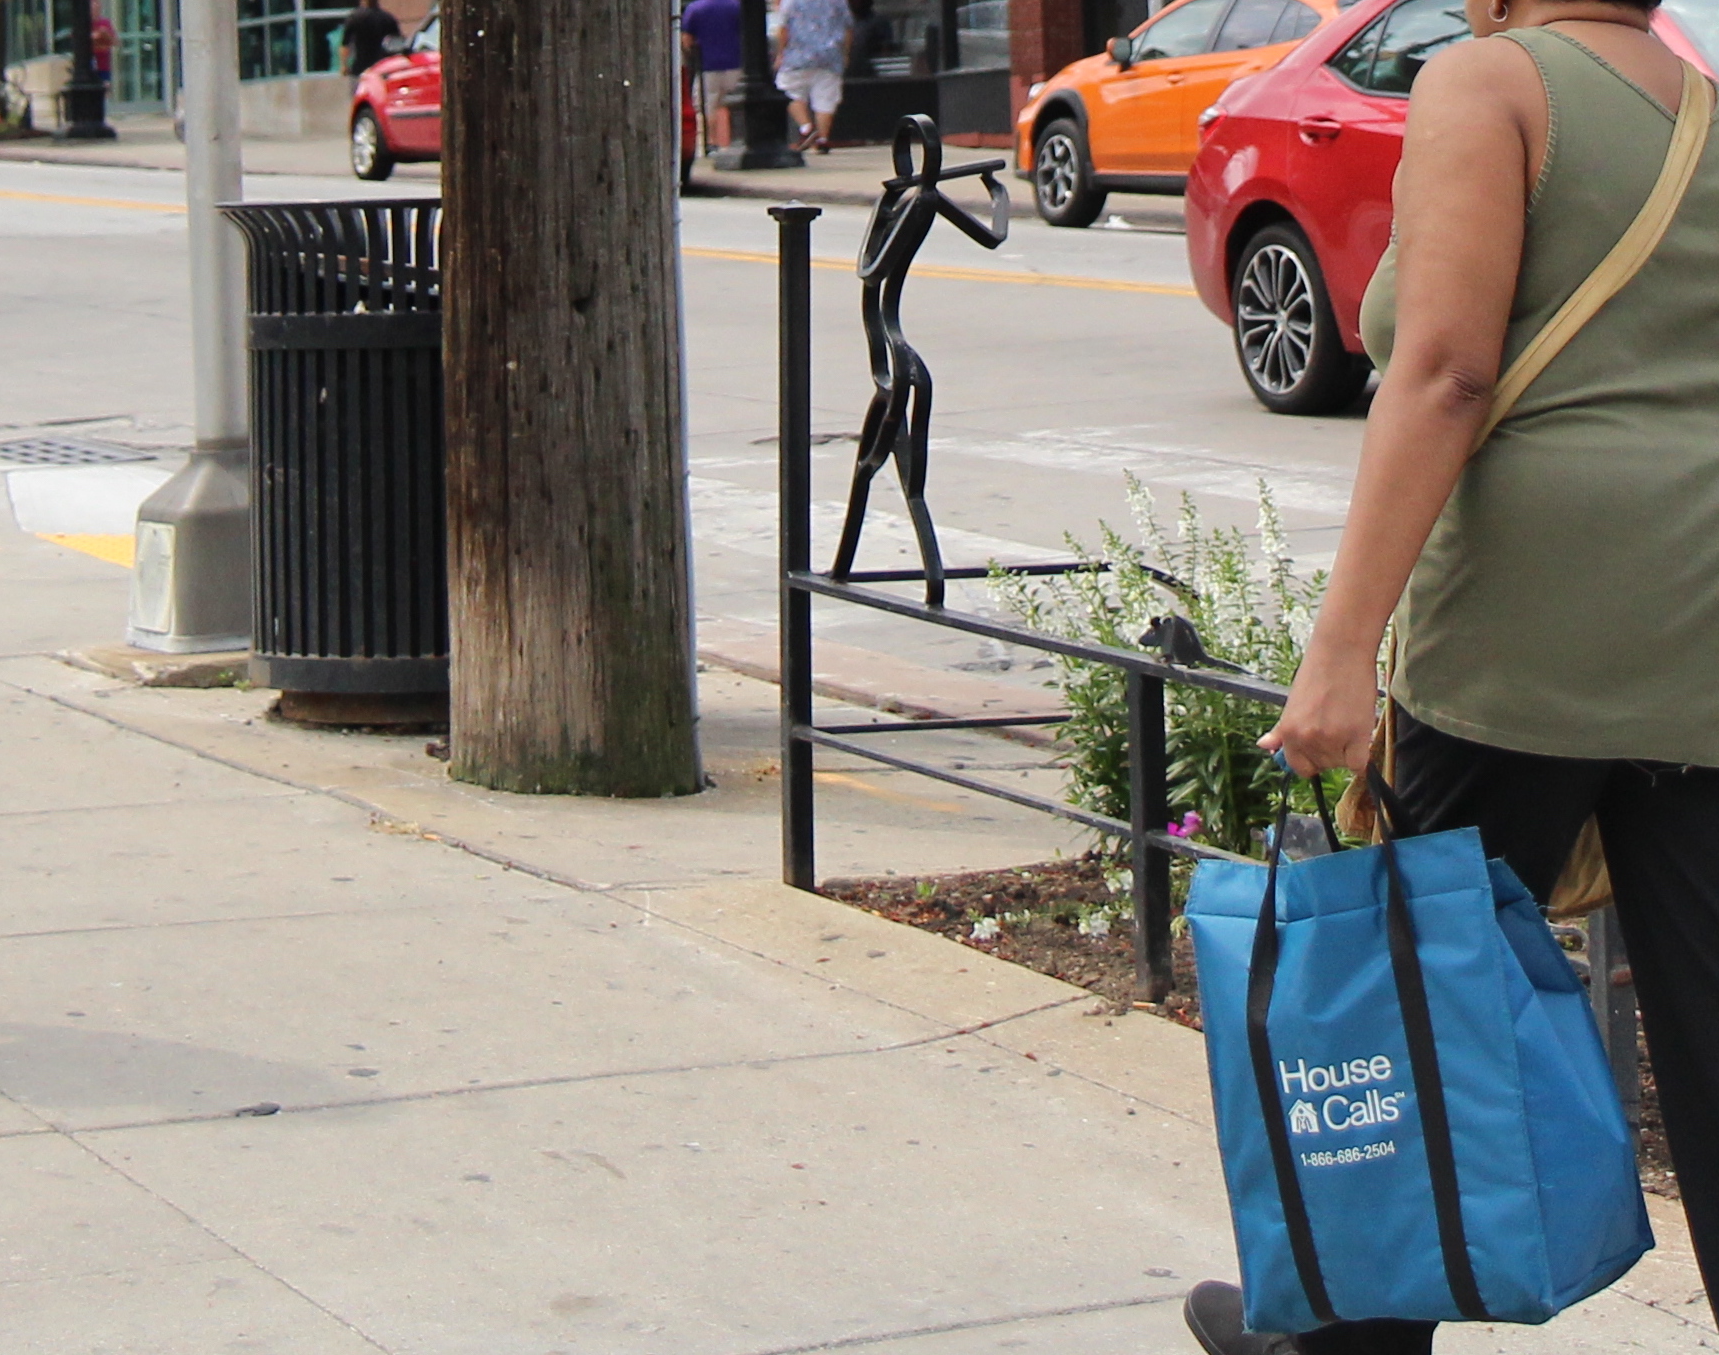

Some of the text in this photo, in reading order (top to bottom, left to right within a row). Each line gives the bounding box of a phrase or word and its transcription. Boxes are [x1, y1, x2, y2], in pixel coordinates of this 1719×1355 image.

[1279, 1054, 1392, 1094] House
[1322, 1088, 1400, 1131] Calls
[1300, 1140, 1396, 1167] 1-866-686-2504
